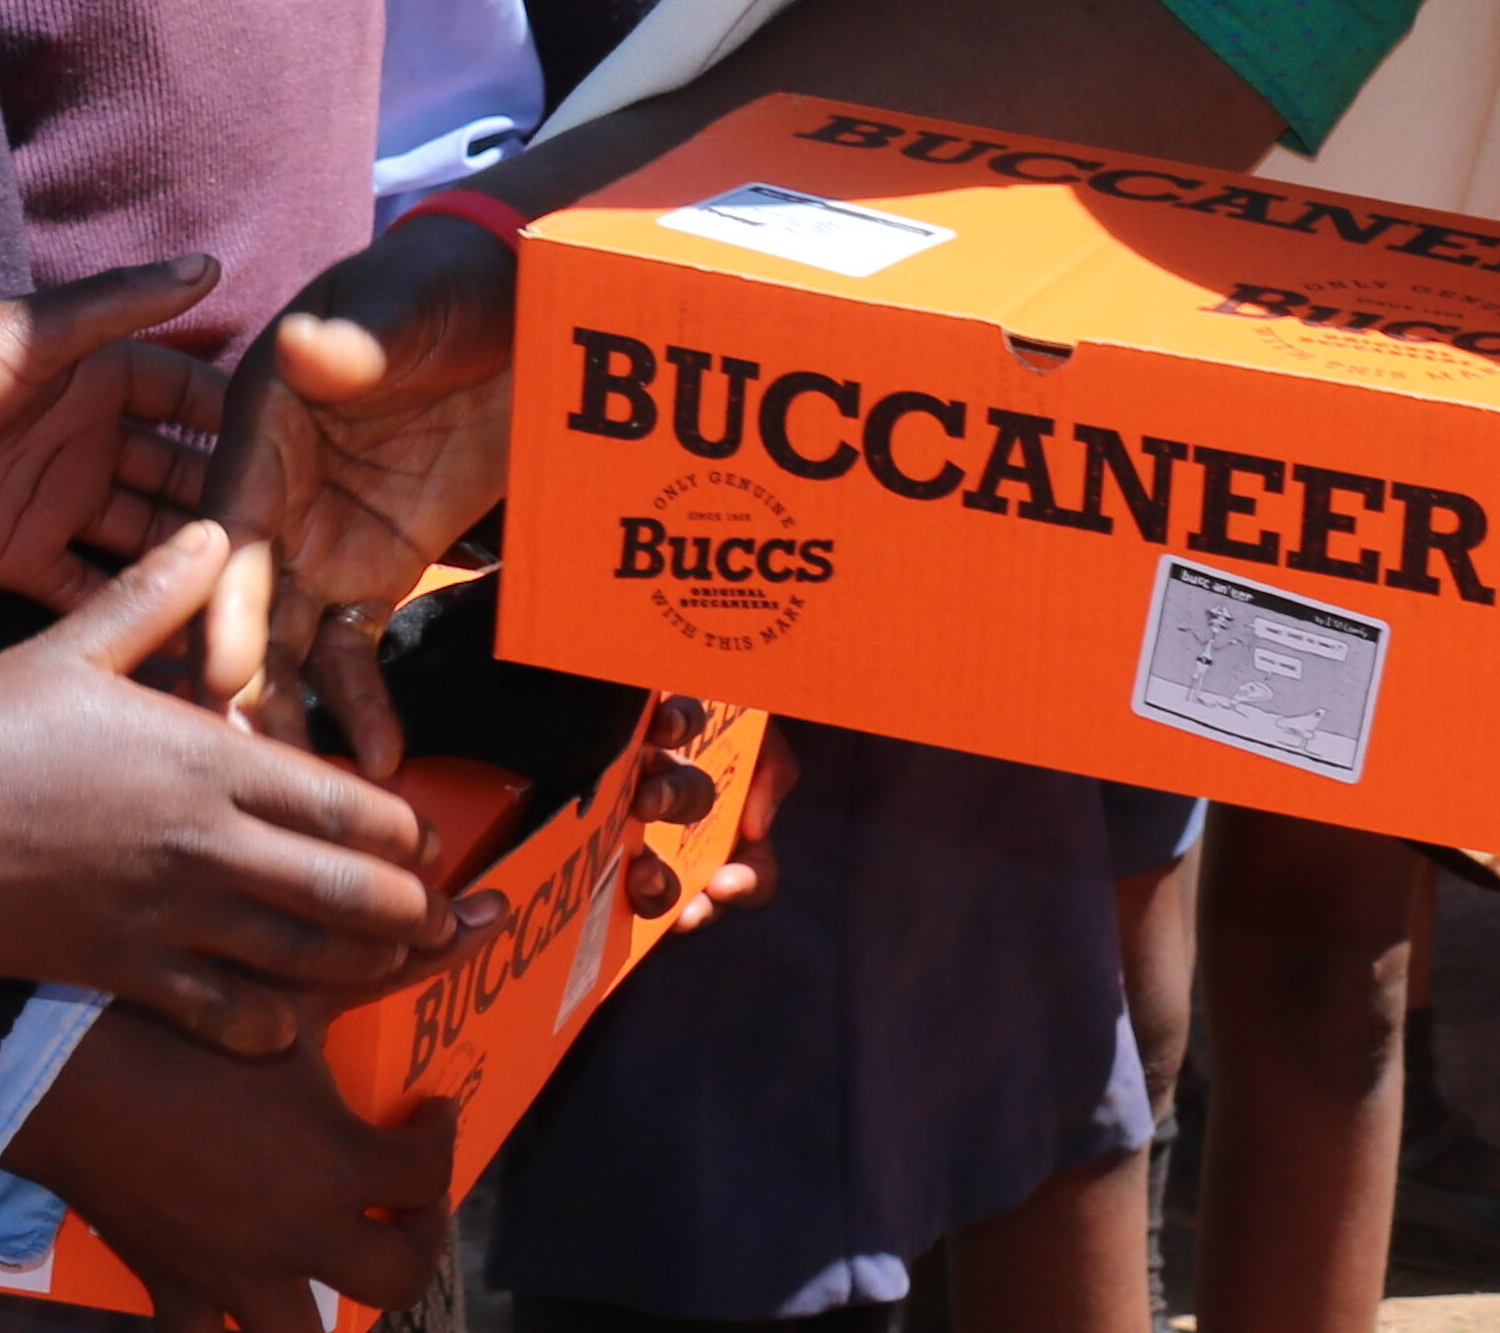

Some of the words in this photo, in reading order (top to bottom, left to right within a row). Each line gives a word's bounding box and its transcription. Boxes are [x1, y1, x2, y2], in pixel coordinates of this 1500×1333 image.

[566, 326, 1497, 606] BUCCANEER
[653, 472, 699, 511] ONLY
[708, 470, 797, 531] GENUINE
[687, 511, 722, 522] SINCE
[613, 516, 836, 584] Buccs
[652, 588, 698, 640] WITH
[704, 632, 755, 653] THIS
[757, 593, 807, 645] MARK
[679, 598, 781, 611] BUCCANEERS
[691, 588, 767, 600] ORIGINAL
